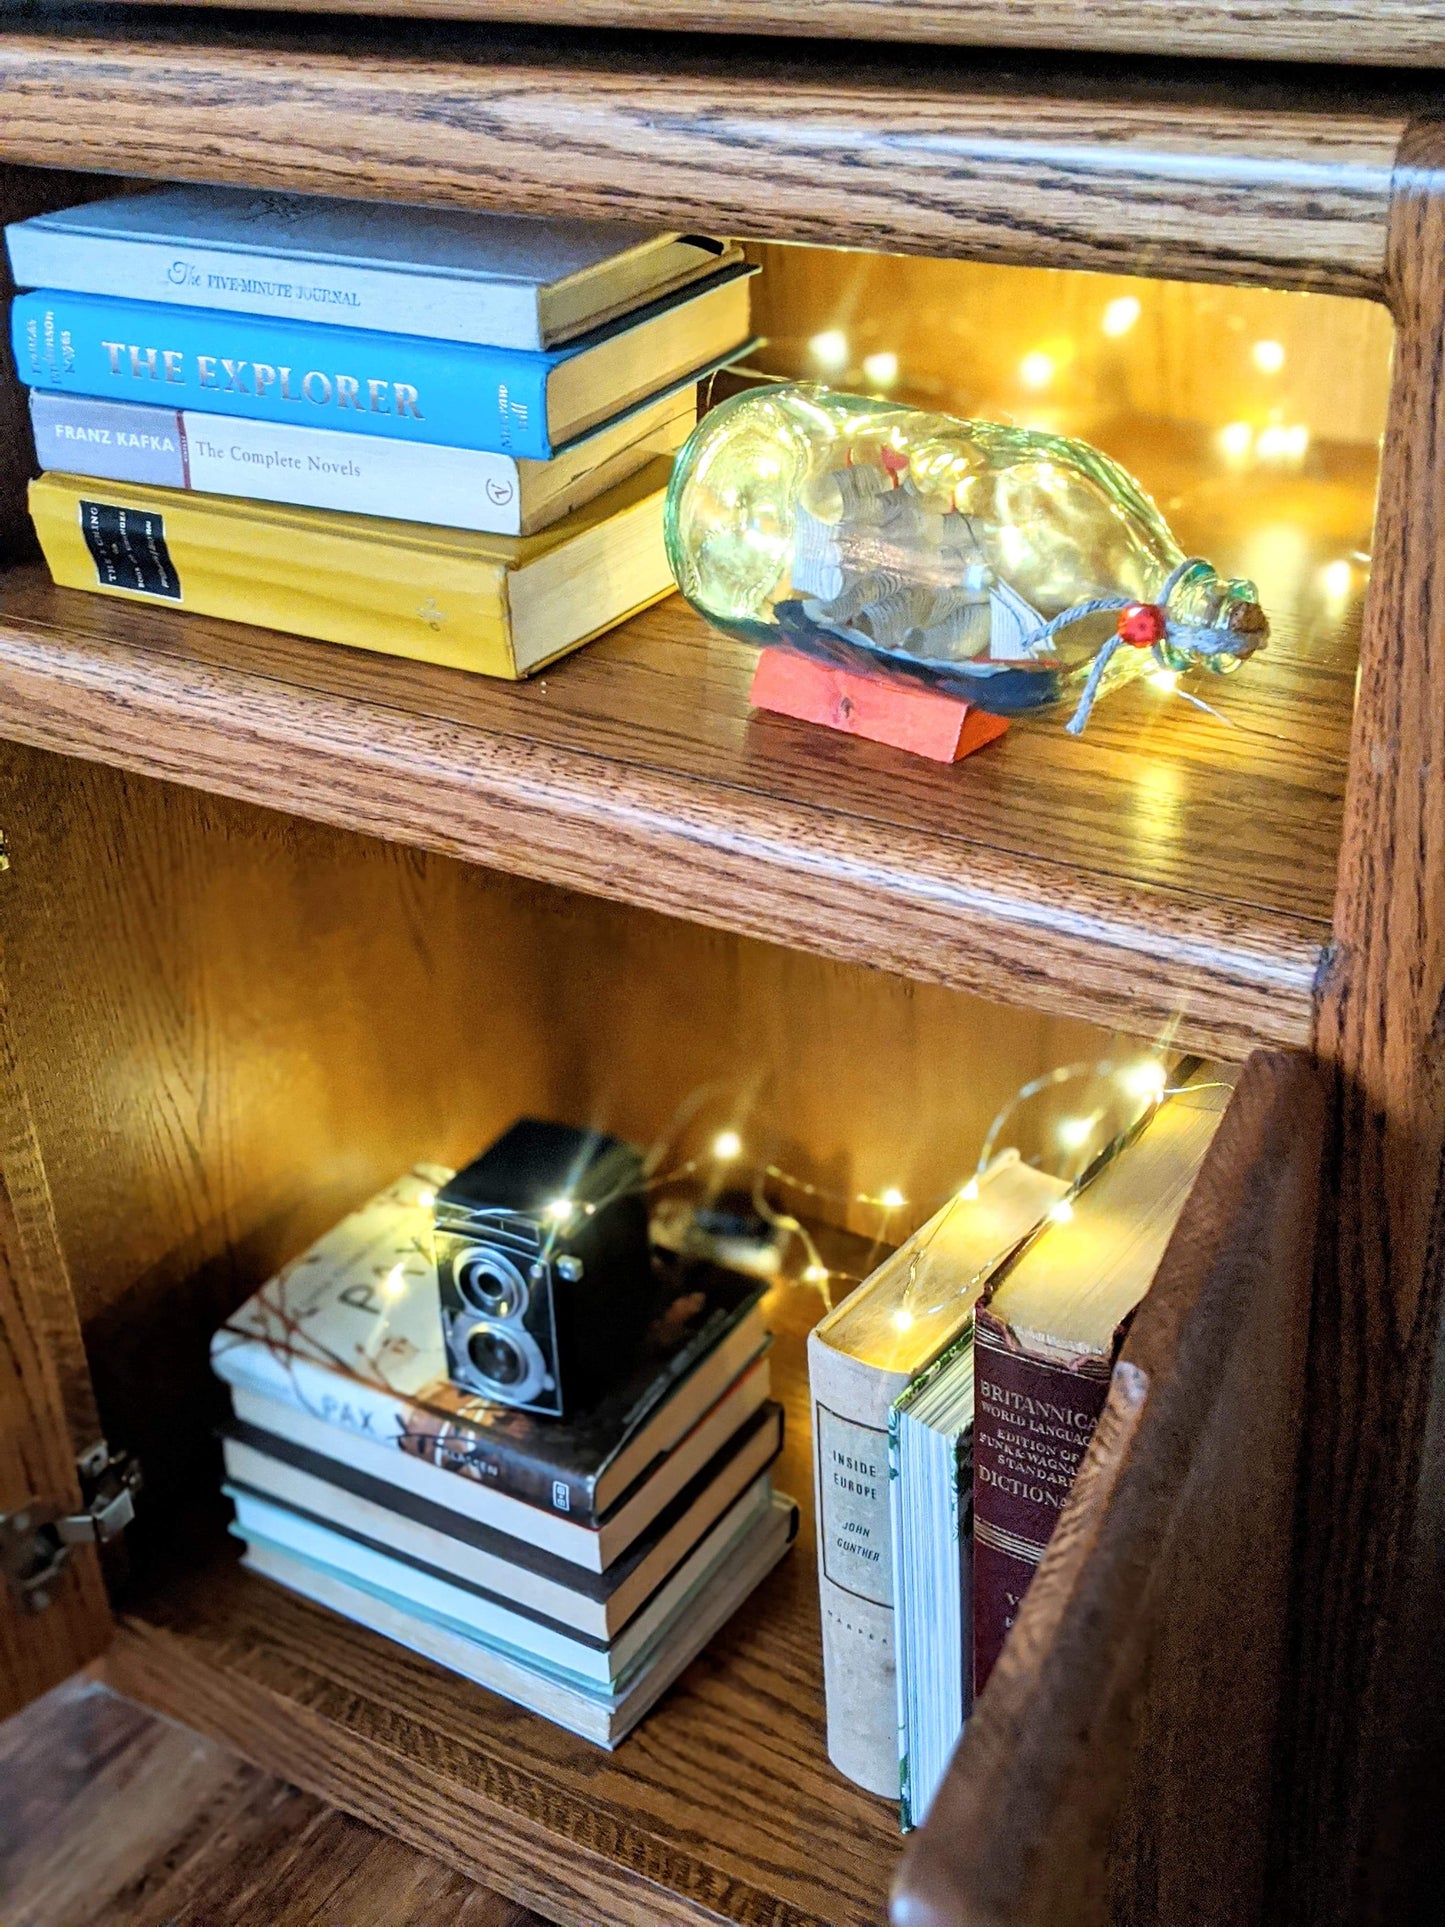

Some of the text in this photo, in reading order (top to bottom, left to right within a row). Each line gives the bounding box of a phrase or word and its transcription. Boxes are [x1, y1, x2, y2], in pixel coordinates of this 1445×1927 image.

[168, 261, 201, 286] The
[297, 286, 361, 307] JOURNAL
[101, 341, 426, 421] THE EXPLORER
[55, 424, 112, 445] FRANZ
[116, 432, 175, 452] KAFKA
[195, 440, 225, 459] The
[231, 446, 302, 470] Complete
[308, 455, 362, 478] Novels
[322, 1395, 375, 1431] PAX
[980, 1400, 1091, 1448] WORLD LANGUAG
[833, 1449, 877, 1478] INSIDE
[979, 1432, 1014, 1456] FUNK
[1026, 1452, 1078, 1477] WAGNA
[997, 1428, 1079, 1463] EDITION OF
[833, 1472, 877, 1500] EUROPE
[979, 1464, 1068, 1510] DICTIONA
[842, 1521, 871, 1538] JOHN
[836, 1537, 880, 1562] GUNTHER
